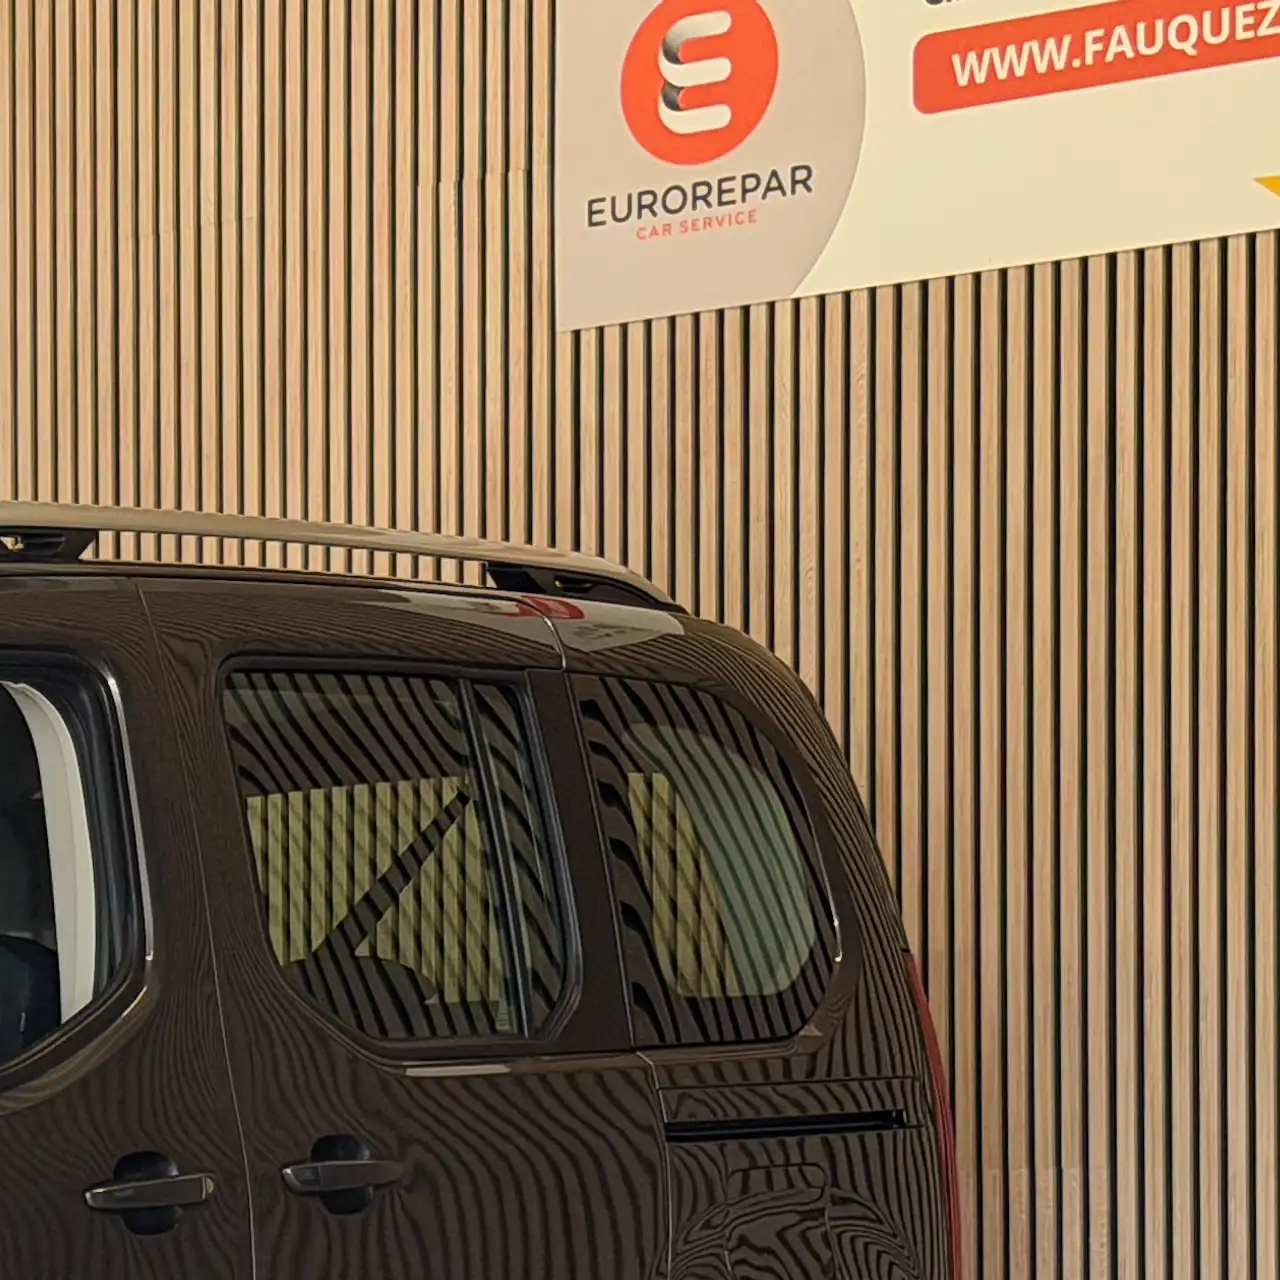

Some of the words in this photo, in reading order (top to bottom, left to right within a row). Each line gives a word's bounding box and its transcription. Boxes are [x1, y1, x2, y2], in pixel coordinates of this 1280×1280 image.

[951, 0, 1280, 87] WWW.FAUQUEZ
[587, 164, 813, 228] EUROREPAR
[636, 222, 673, 240] CAR
[679, 208, 758, 234] SERVICE
